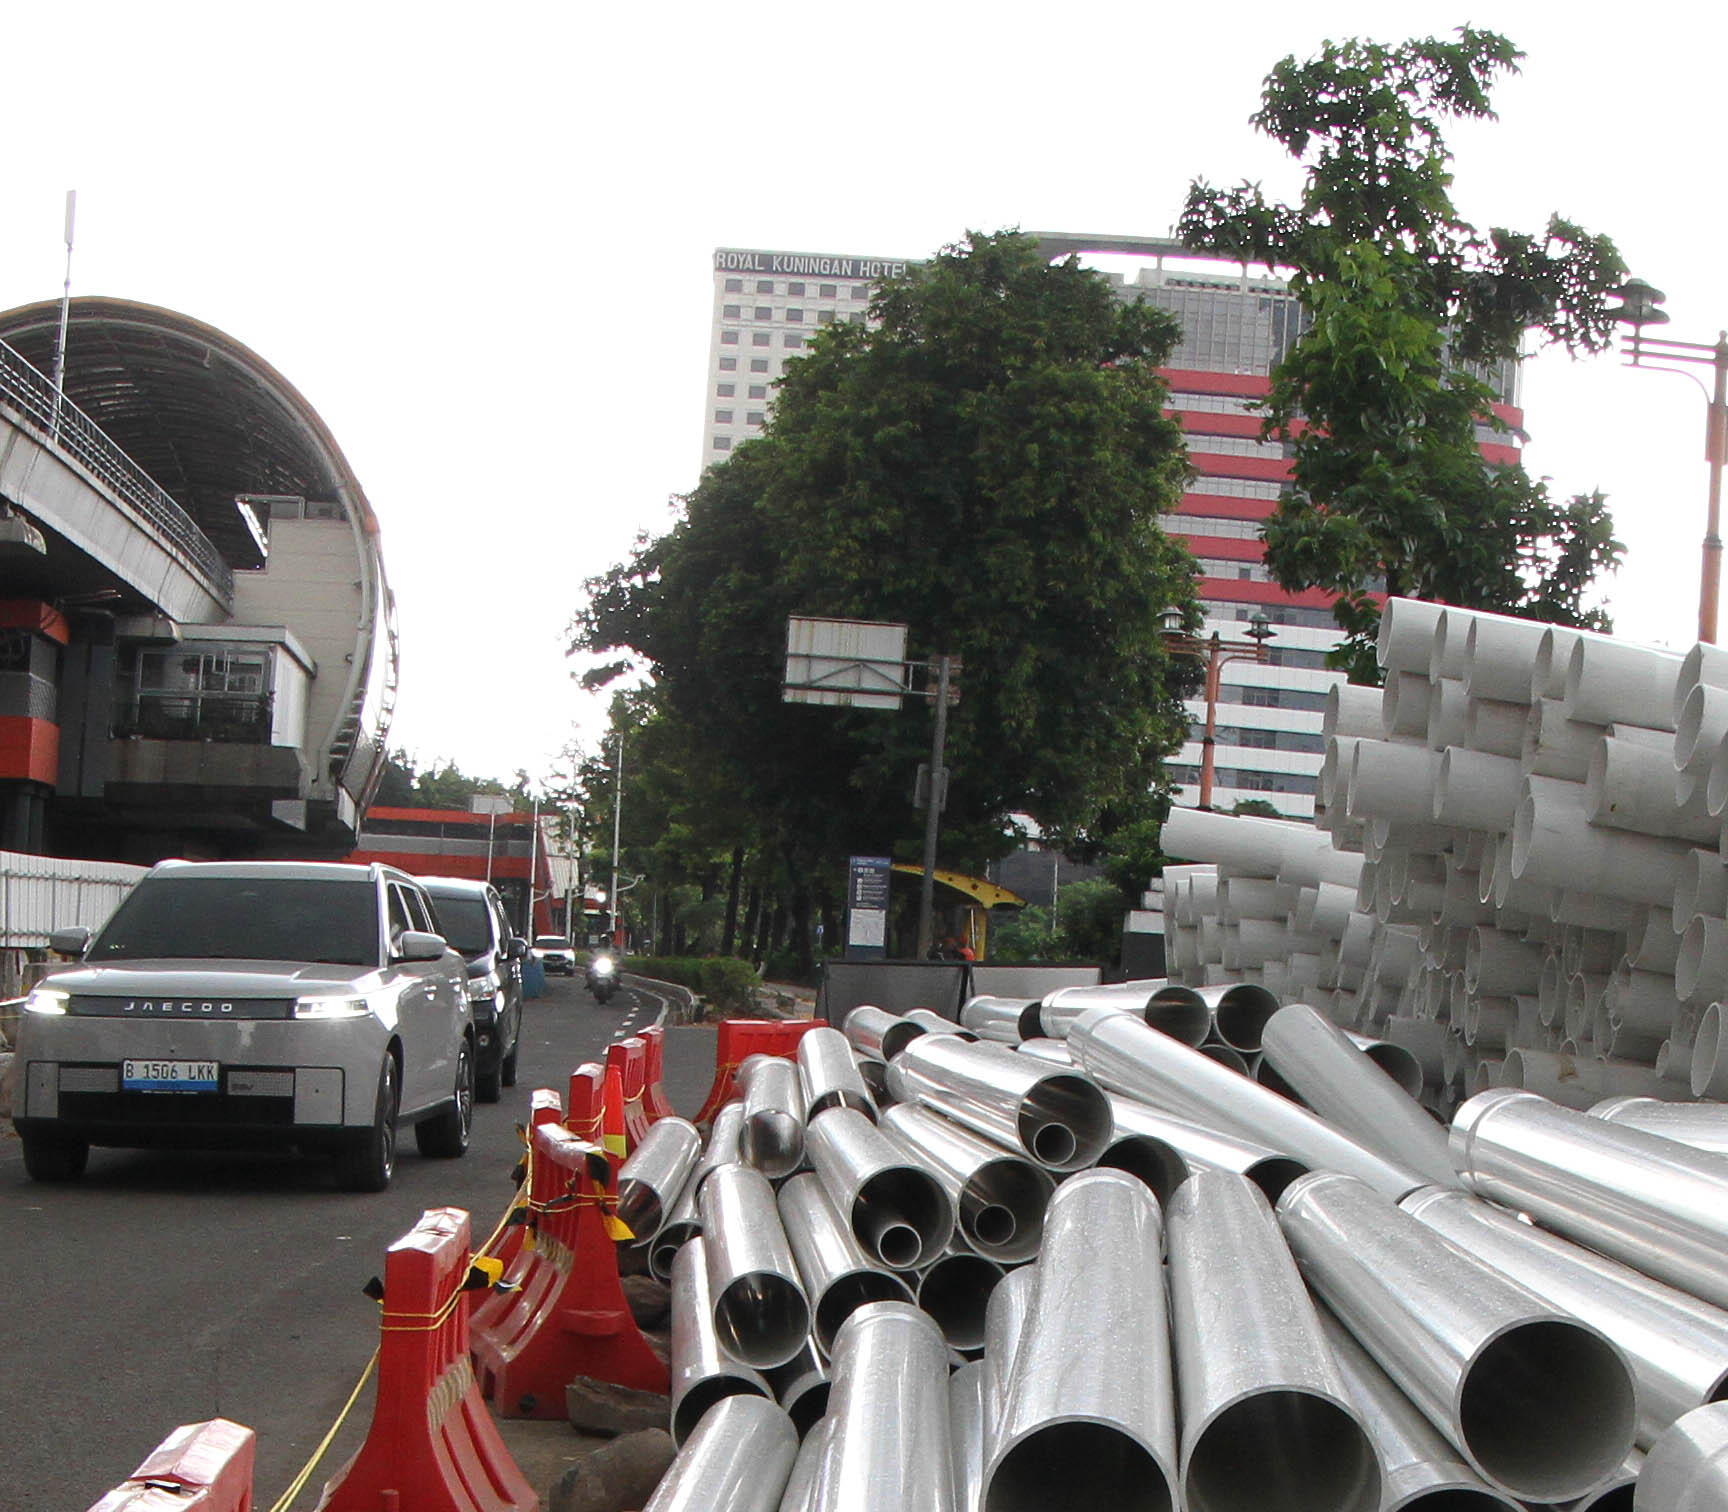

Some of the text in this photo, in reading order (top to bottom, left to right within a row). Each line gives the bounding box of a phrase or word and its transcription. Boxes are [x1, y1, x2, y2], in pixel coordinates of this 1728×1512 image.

[715, 252, 765, 271] ROYAL
[773, 255, 852, 276] KUNINGAN
[123, 1001, 233, 1013] JAECOO
[125, 1063, 215, 1081] B 1506 LKK
